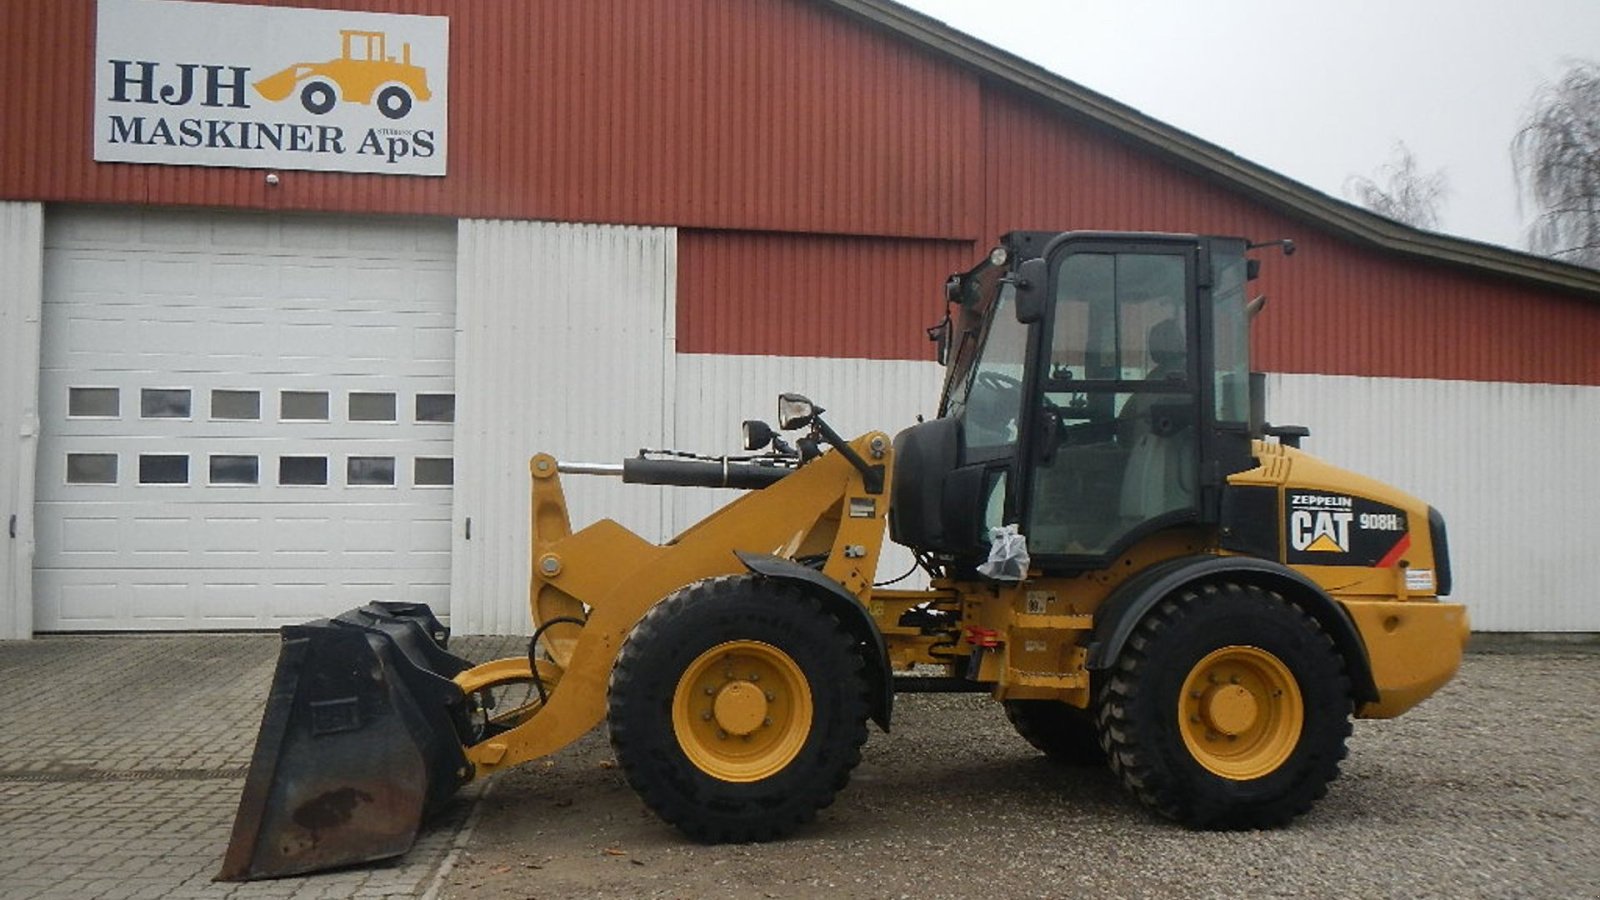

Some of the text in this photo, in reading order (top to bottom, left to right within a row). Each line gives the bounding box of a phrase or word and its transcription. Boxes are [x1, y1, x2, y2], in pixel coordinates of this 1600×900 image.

[107, 60, 251, 109] HJH
[108, 115, 435, 163] MASKINER ApS
[1292, 495, 1352, 506] ZEPPELIN
[1292, 510, 1353, 553] CAT
